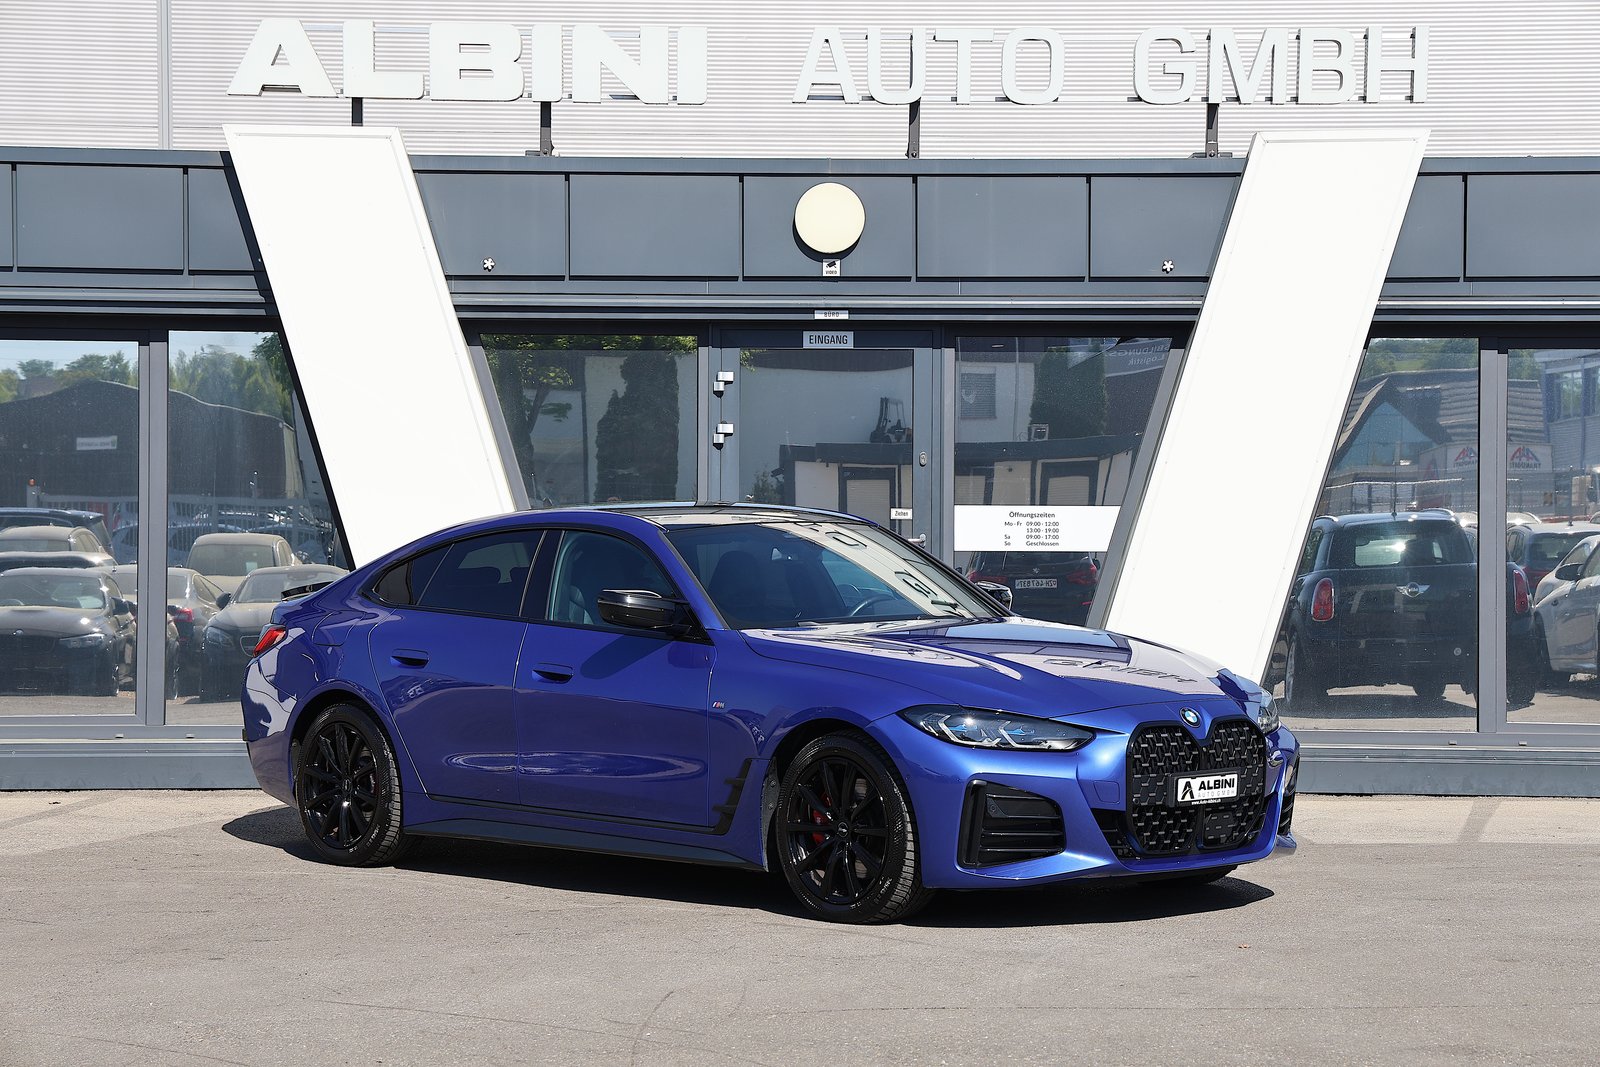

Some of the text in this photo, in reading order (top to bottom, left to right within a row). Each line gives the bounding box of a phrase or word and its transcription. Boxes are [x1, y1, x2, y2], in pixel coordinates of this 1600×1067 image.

[226, 18, 1430, 105] ALBINI AUTO GMBH
[808, 334, 848, 344] EINGANG
[1008, 511, 1056, 519] Öffnungszeiten
[1198, 778, 1235, 791] ALBINI
